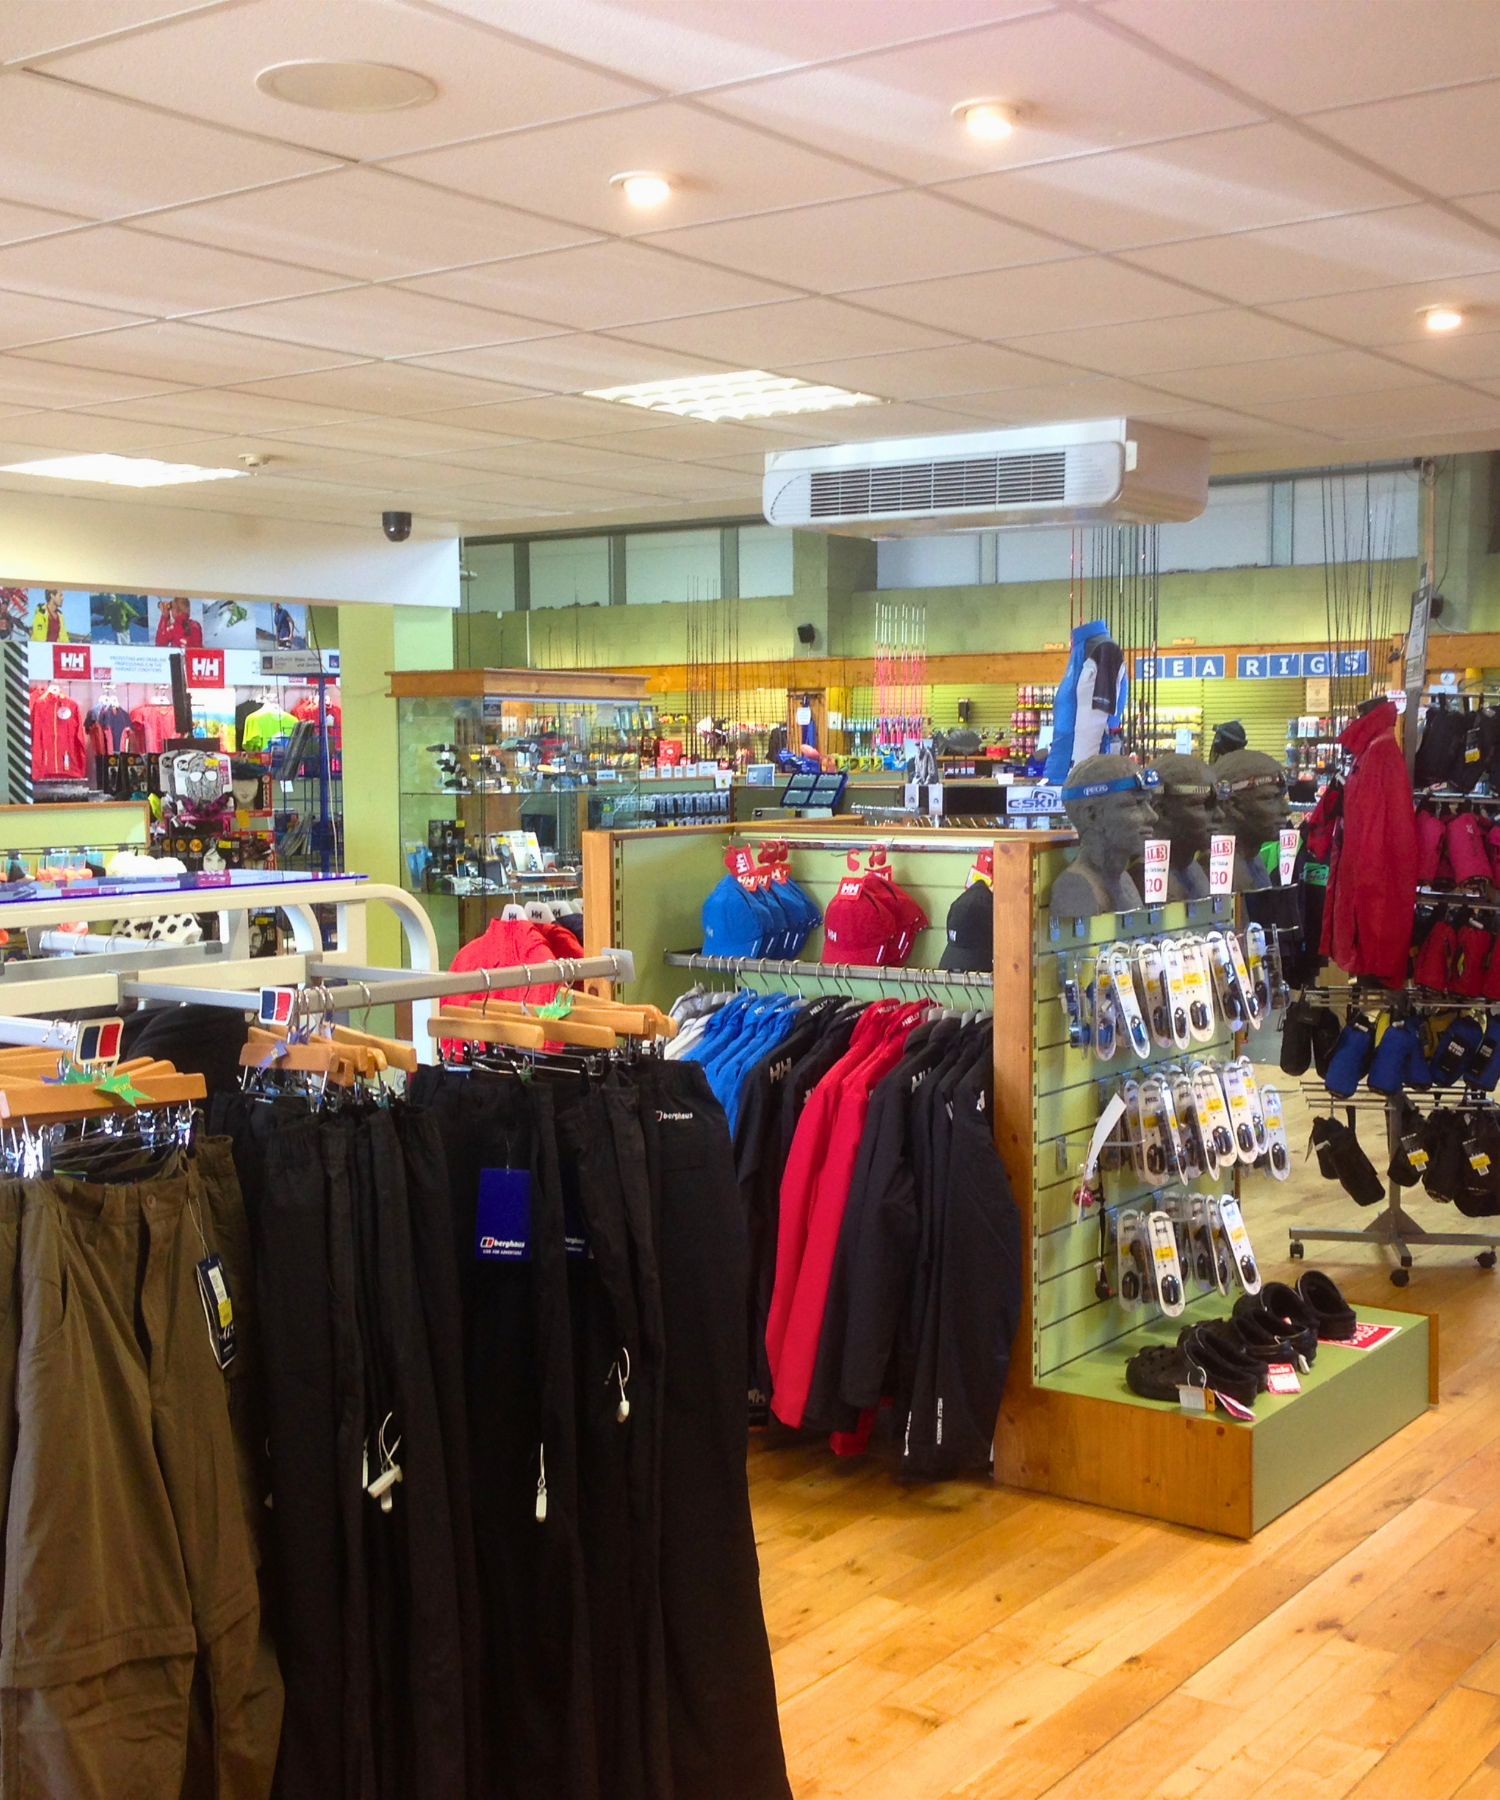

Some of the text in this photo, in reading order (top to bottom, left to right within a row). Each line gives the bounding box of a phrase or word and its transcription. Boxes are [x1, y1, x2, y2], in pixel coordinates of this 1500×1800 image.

[61, 653, 84, 668] HH
[192, 658, 219, 676] HH
[1143, 655, 1359, 677] SEA RIGS
[841, 883, 860, 895] HH
[531, 909, 543, 919] HH
[769, 1057, 792, 1084] HH
[663, 1112, 693, 1121] berghaus
[494, 1239, 525, 1248] berghaus
